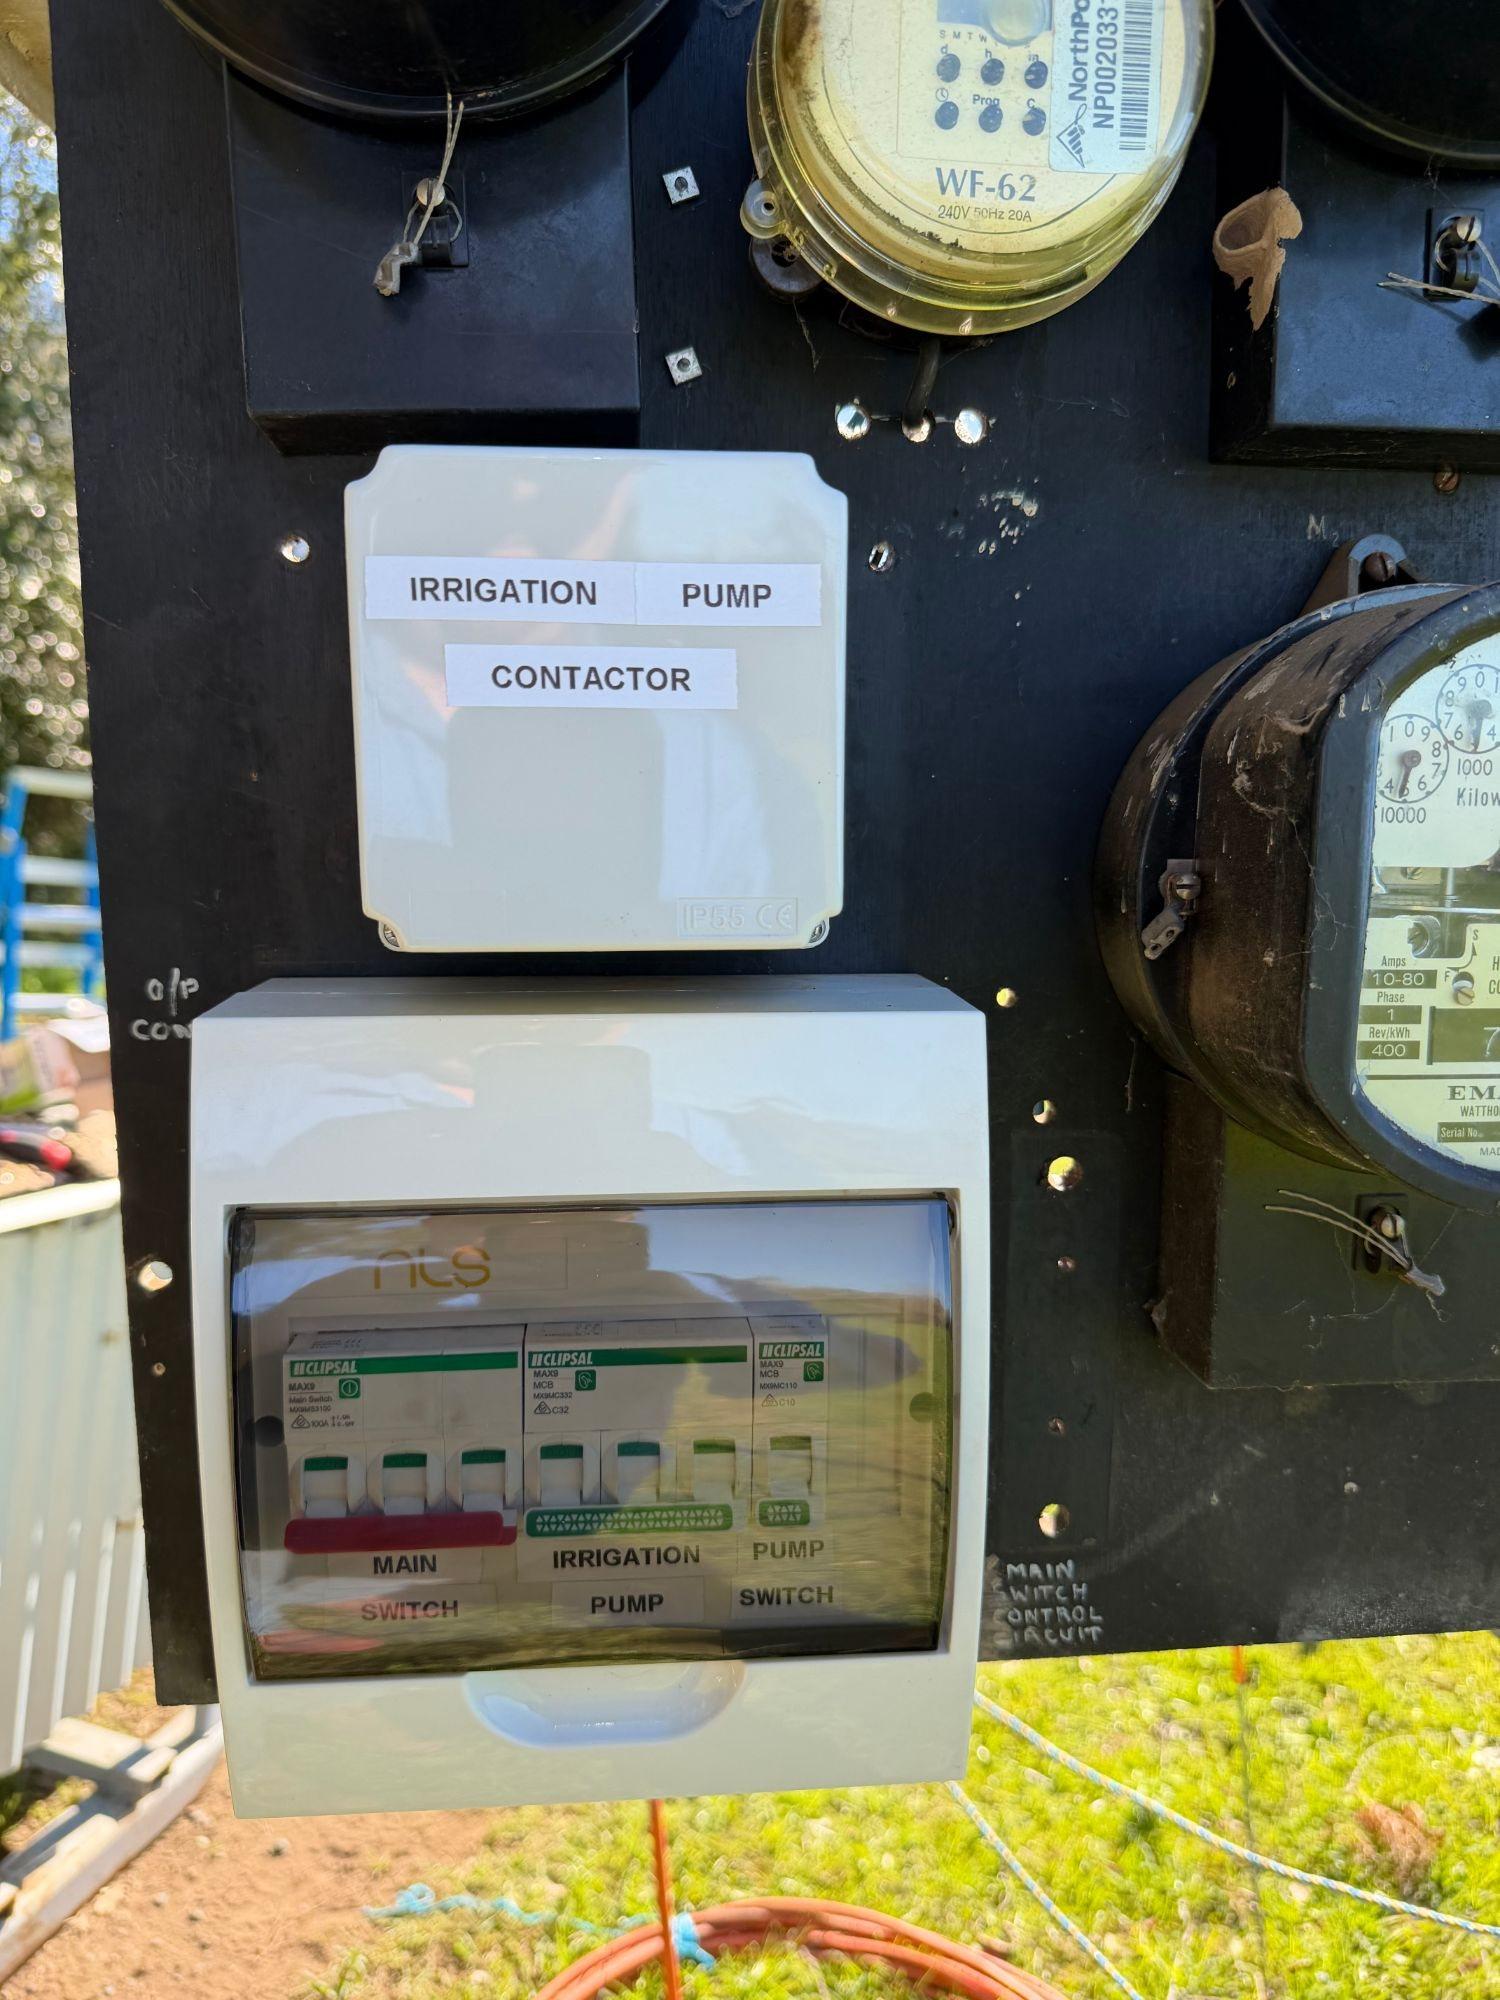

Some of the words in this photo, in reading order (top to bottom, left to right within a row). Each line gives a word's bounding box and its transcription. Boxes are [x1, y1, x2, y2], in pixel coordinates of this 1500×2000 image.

[1092, 0, 1118, 129] NP002033
[936, 167, 1036, 201] WF-62
[938, 205, 970, 220] 240V
[974, 208, 1004, 220] 50Hz
[1008, 210, 1032, 222] 20A
[410, 576, 598, 605] IRRIGATION
[682, 583, 772, 609] PUMP
[491, 664, 691, 692] CONTACTOR
[1457, 759, 1493, 776] 1000
[1380, 806, 1427, 824] 10000
[683, 903, 745, 930] IP55
[1381, 955, 1406, 968] Amps
[1372, 972, 1424, 986] 10-80
[1377, 991, 1405, 1003] Phase
[1387, 1009, 1394, 1021] 1
[1369, 1026, 1410, 1040] Rev/kWh
[1372, 1044, 1406, 1057] 400
[1447, 1085, 1500, 1101] EM
[1441, 1127, 1465, 1138] Serial
[773, 1343, 822, 1357] CLIPSAL
[543, 1352, 593, 1366] CLIPSAL
[306, 1361, 357, 1375] CLIPSAL
[533, 1370, 559, 1378] MAX9
[760, 1369, 780, 1378] MCB
[533, 1381, 554, 1389] MCB
[552, 1544, 701, 1569] IRRIGATION
[752, 1539, 825, 1561] PUMP
[373, 1554, 437, 1575] MAIN
[1006, 1559, 1075, 1580] MAIN
[590, 1593, 664, 1614] PUMP
[739, 1585, 834, 1607] SWITCH
[361, 1599, 459, 1621] SWITCH
